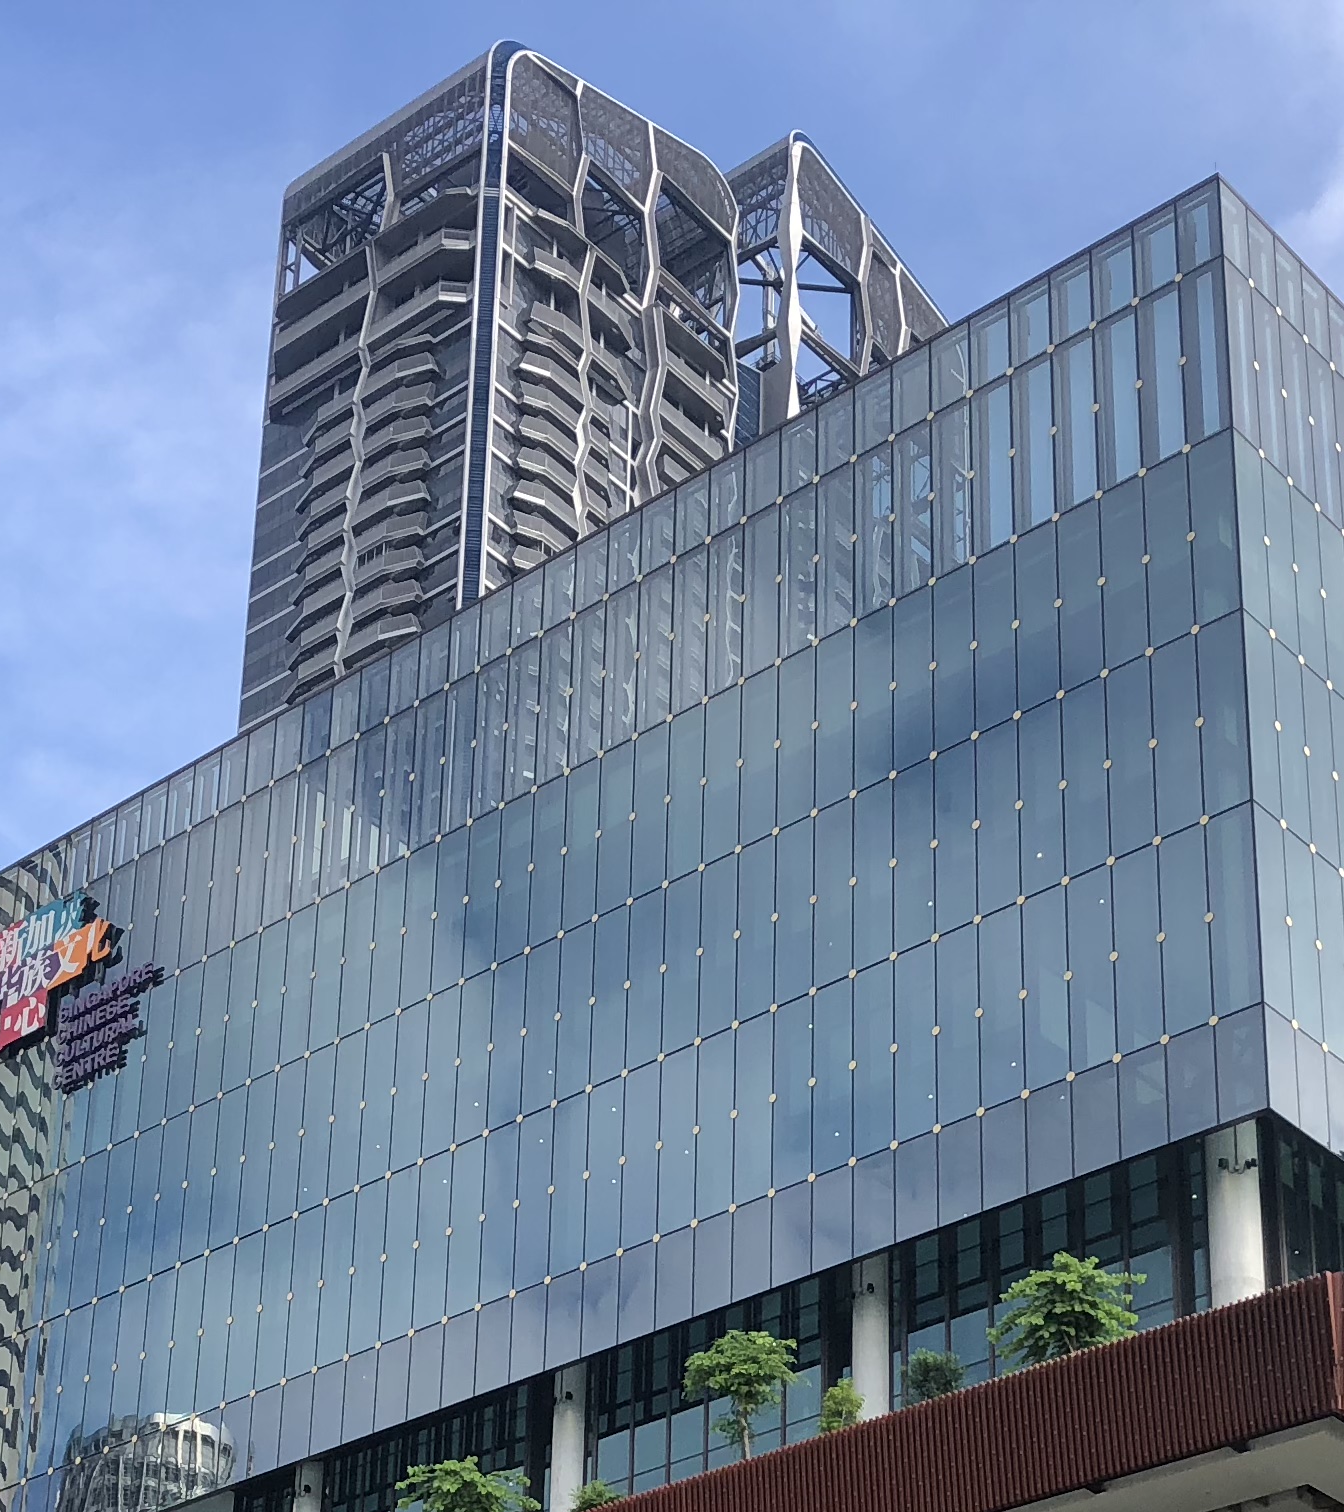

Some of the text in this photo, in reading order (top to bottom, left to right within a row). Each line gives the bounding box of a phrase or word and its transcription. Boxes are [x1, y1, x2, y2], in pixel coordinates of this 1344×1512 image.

[58, 961, 154, 1024] SINGAPORE
[54, 1013, 137, 1067] CULTURAL
[55, 994, 131, 1046] CHINESE
[51, 1042, 120, 1091] CENTRE
